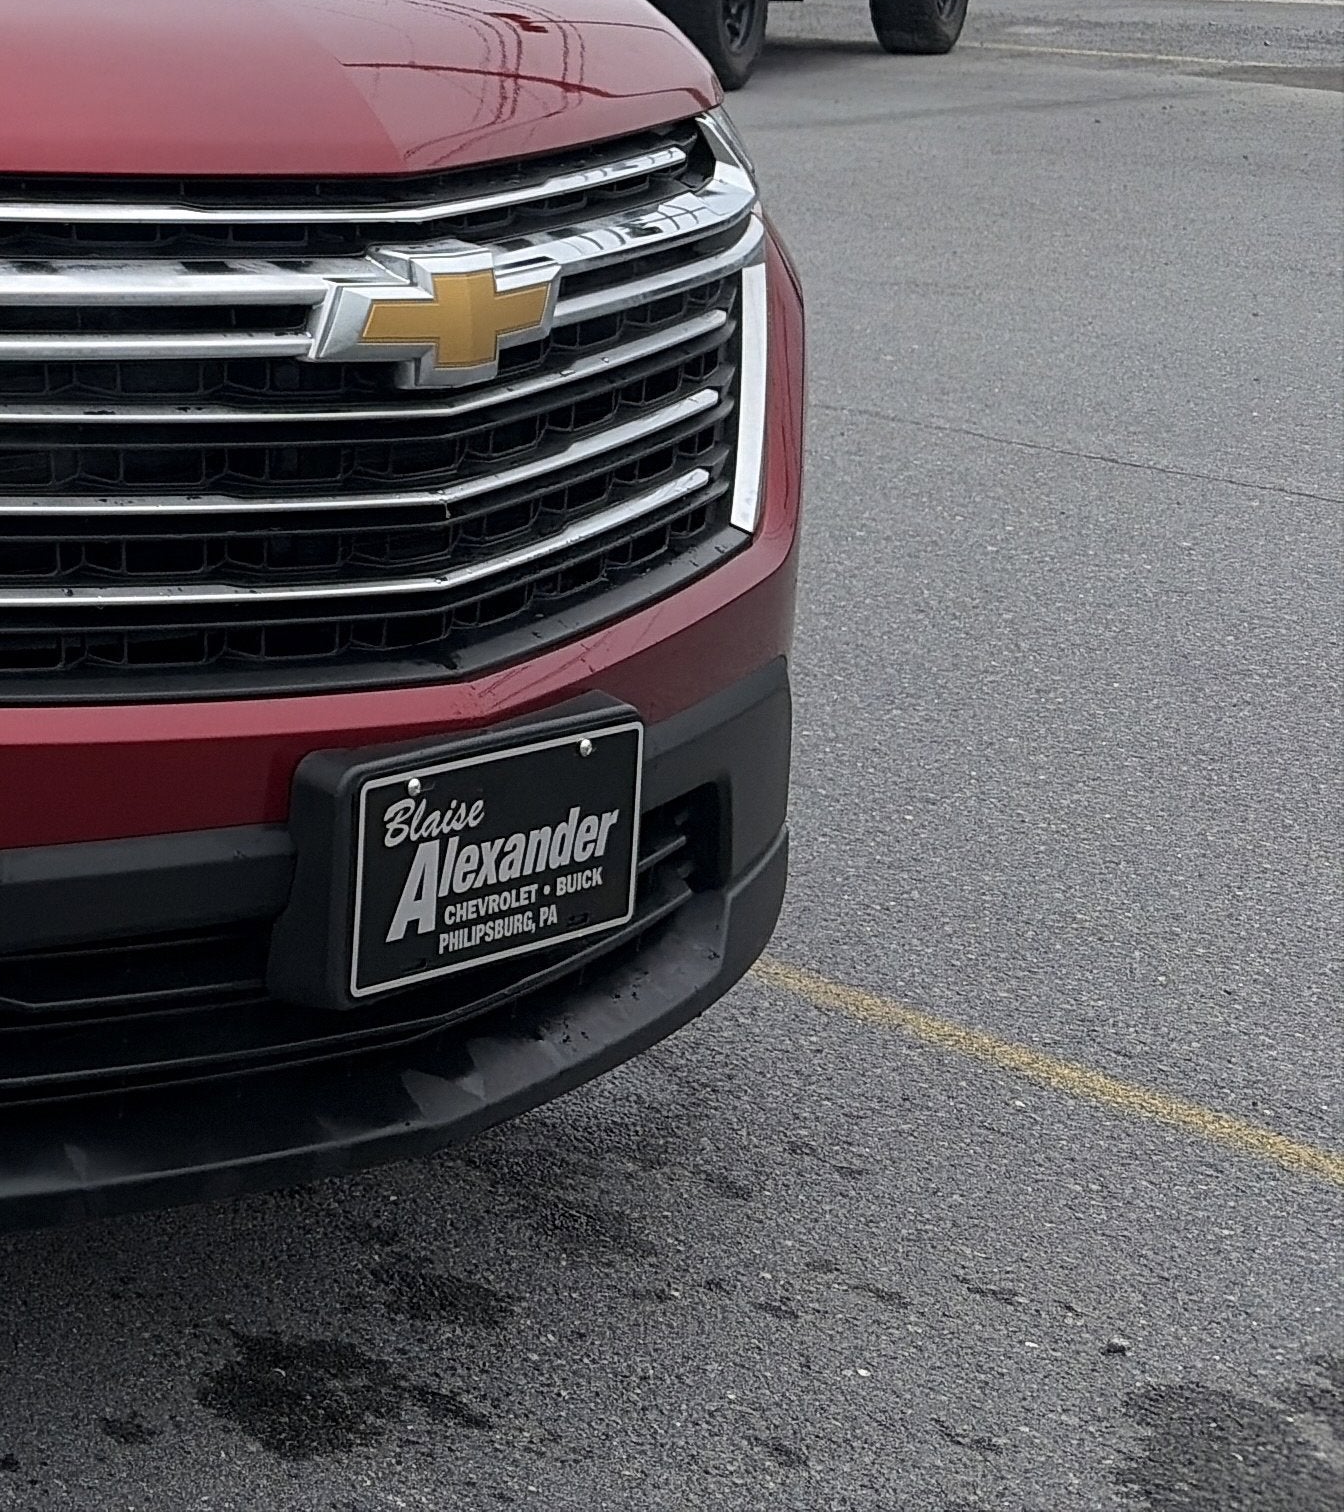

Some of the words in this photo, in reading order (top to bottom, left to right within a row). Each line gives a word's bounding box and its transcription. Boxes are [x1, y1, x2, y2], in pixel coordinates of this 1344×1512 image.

[383, 797, 485, 848] Blaise
[385, 806, 620, 944] Alexander
[443, 884, 539, 926] CHEVROLET
[555, 867, 603, 898] BUICK
[438, 912, 537, 955] PHILIPSBURG,
[539, 904, 558, 927] PA
